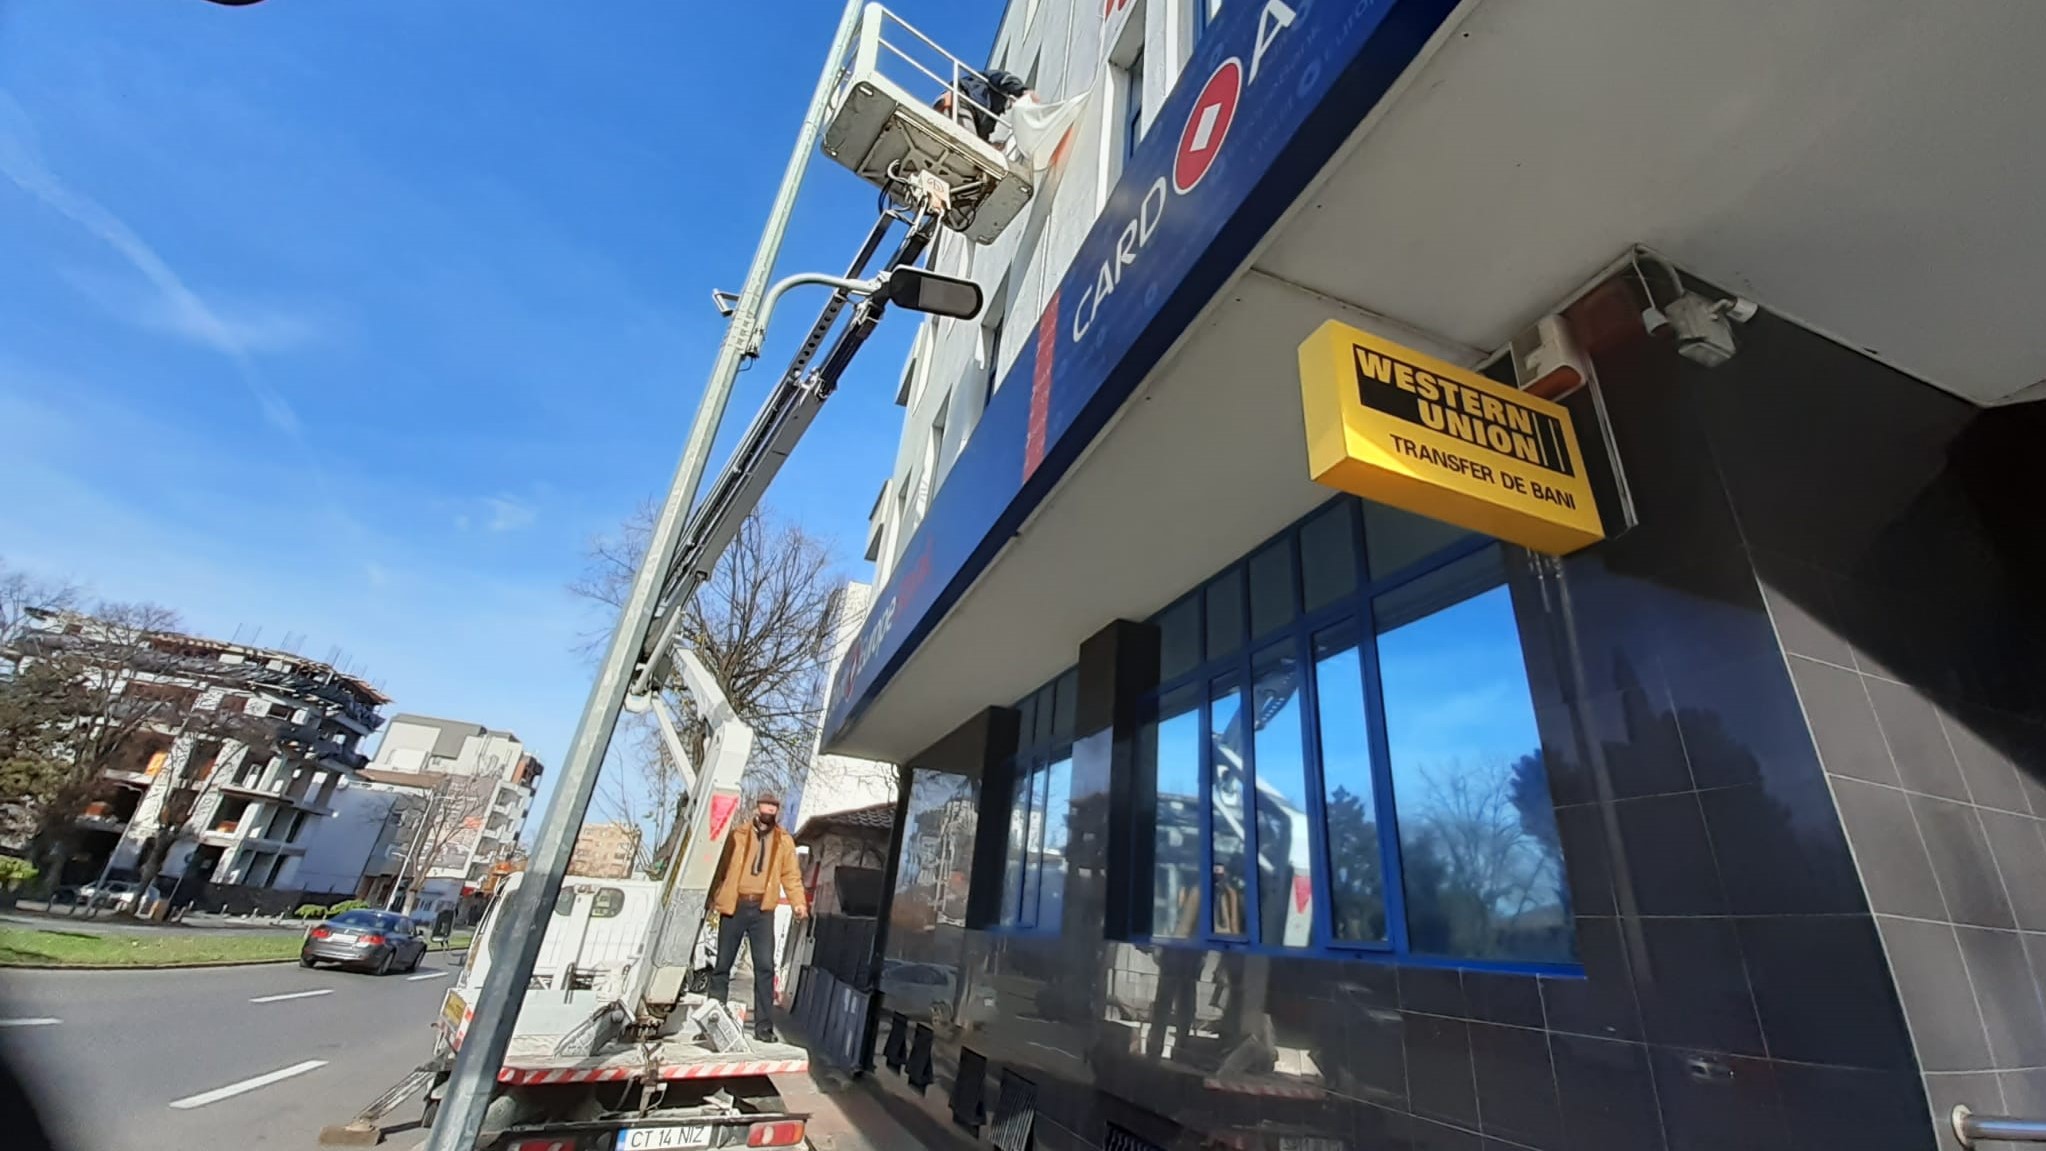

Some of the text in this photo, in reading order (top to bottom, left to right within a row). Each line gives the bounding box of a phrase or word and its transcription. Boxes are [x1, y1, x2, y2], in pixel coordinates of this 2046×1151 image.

[1072, 176, 1168, 343] CARD
[1355, 346, 1533, 436] WESTERN
[1417, 399, 1541, 466] UNION
[1389, 434, 1577, 510] TRANSFER DE BANI
[631, 1126, 704, 1148] CT 14 NIZ
